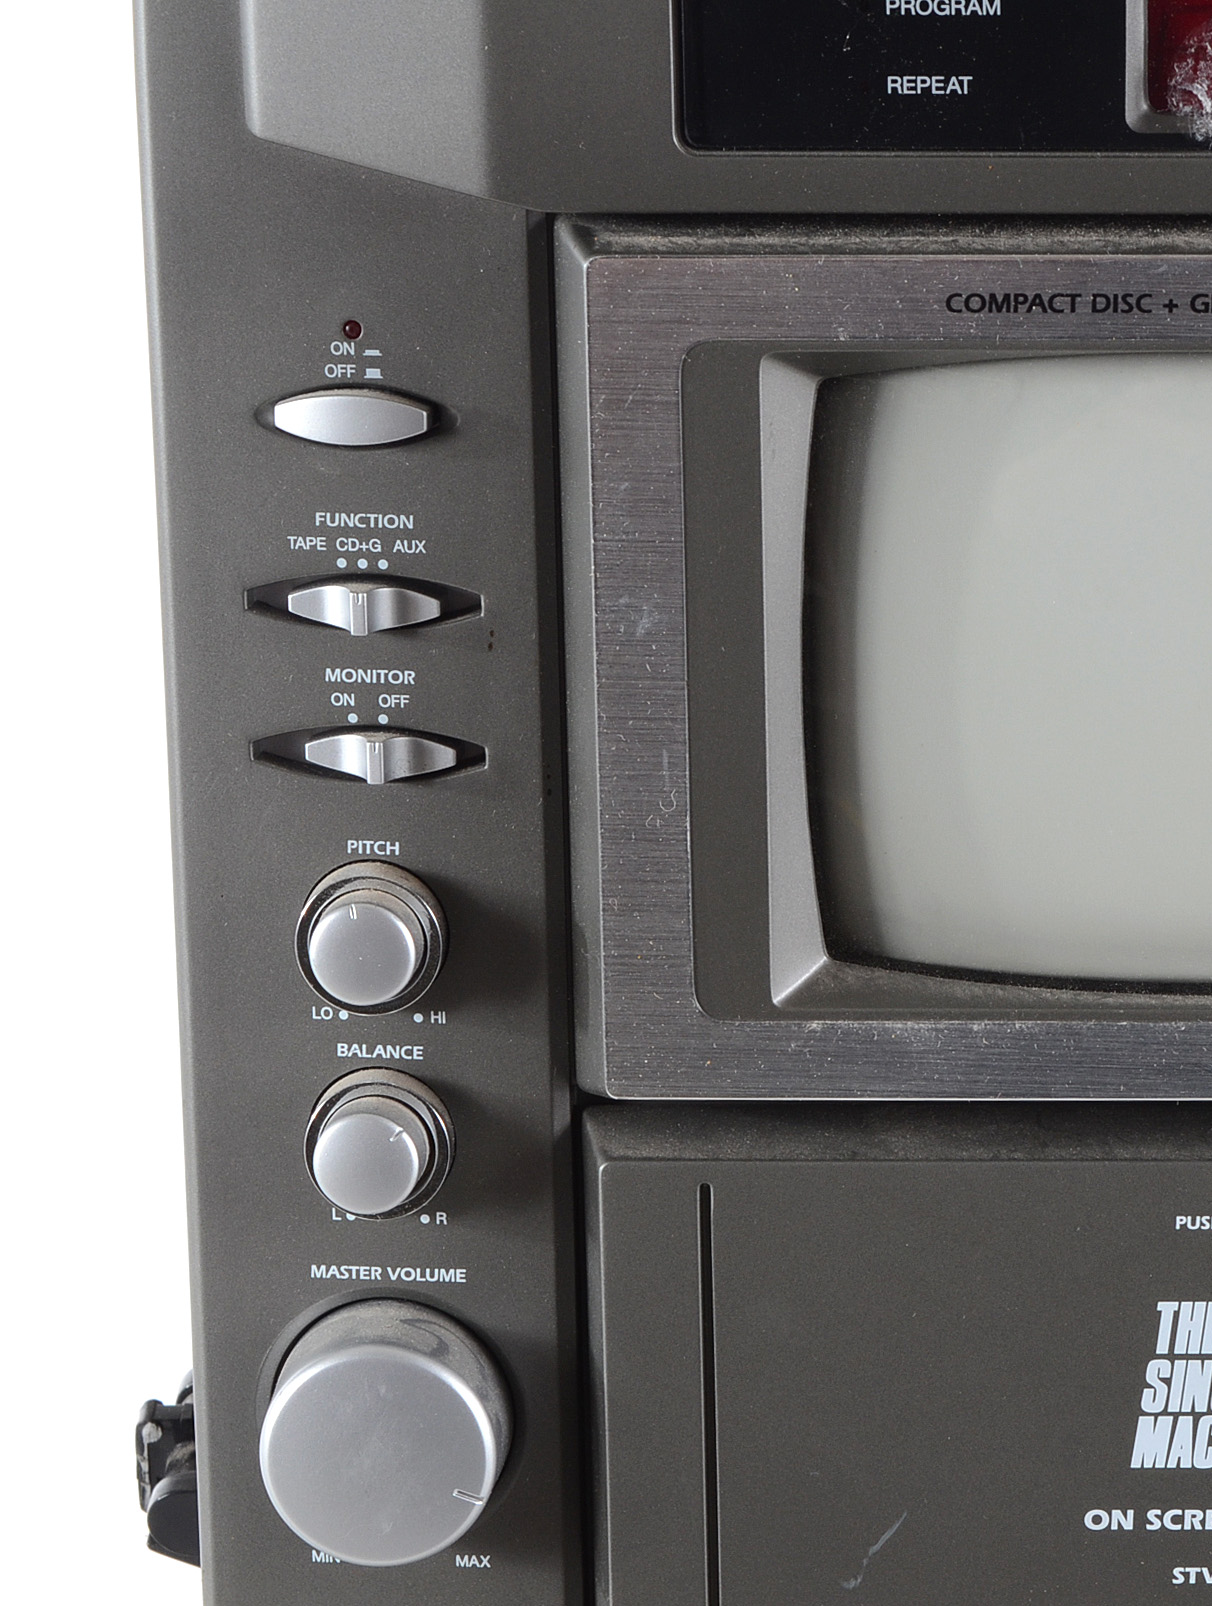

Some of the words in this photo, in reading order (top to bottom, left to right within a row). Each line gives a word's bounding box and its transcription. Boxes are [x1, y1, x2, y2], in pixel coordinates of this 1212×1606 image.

[885, 0, 1002, 16] PROGRAM
[887, 75, 973, 95] REPEAT
[945, 292, 1082, 314] COMPACT
[1090, 292, 1152, 314] DISC
[1162, 298, 1179, 314] +
[330, 341, 355, 356] ON
[324, 364, 356, 379] OFF
[314, 512, 414, 530] FUNCTION
[287, 536, 326, 551] TAPE
[335, 537, 382, 553] CD+G
[393, 539, 426, 554] AUX
[325, 667, 415, 685] MONITOR
[331, 692, 355, 707] ON
[378, 693, 410, 709] OFF
[347, 839, 400, 856] PITCH
[312, 1006, 333, 1020] LO
[430, 1011, 446, 1025] HI
[337, 1043, 424, 1061] BALANCE
[331, 1208, 342, 1221] L
[435, 1211, 448, 1225] R
[311, 1265, 381, 1281] MASTER
[388, 1267, 467, 1283] VOLUME
[1084, 1509, 1134, 1531] ON
[456, 1555, 491, 1570] MAX
